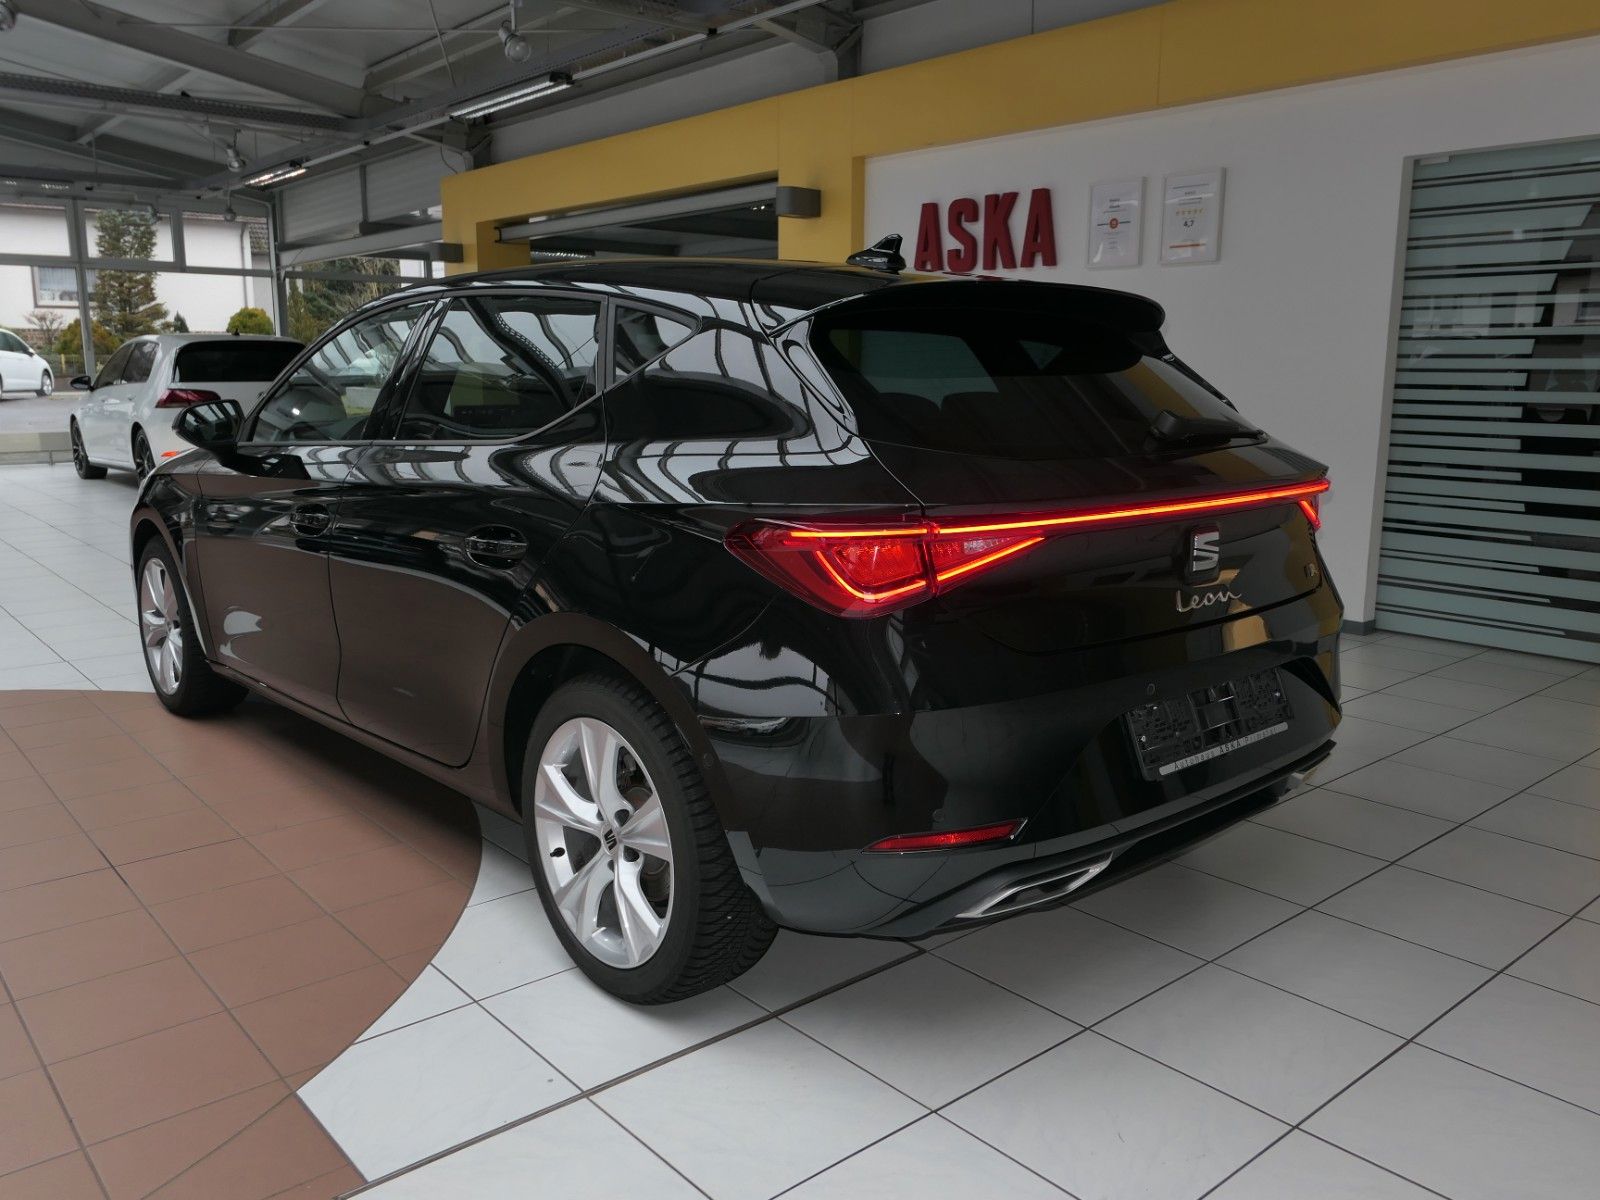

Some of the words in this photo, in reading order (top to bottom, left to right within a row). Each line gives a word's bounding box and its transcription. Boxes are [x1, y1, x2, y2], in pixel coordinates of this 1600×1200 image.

[914, 187, 1058, 273] ASKA
[1175, 590, 1242, 613] Leon
[1219, 739, 1241, 755] ASKA
